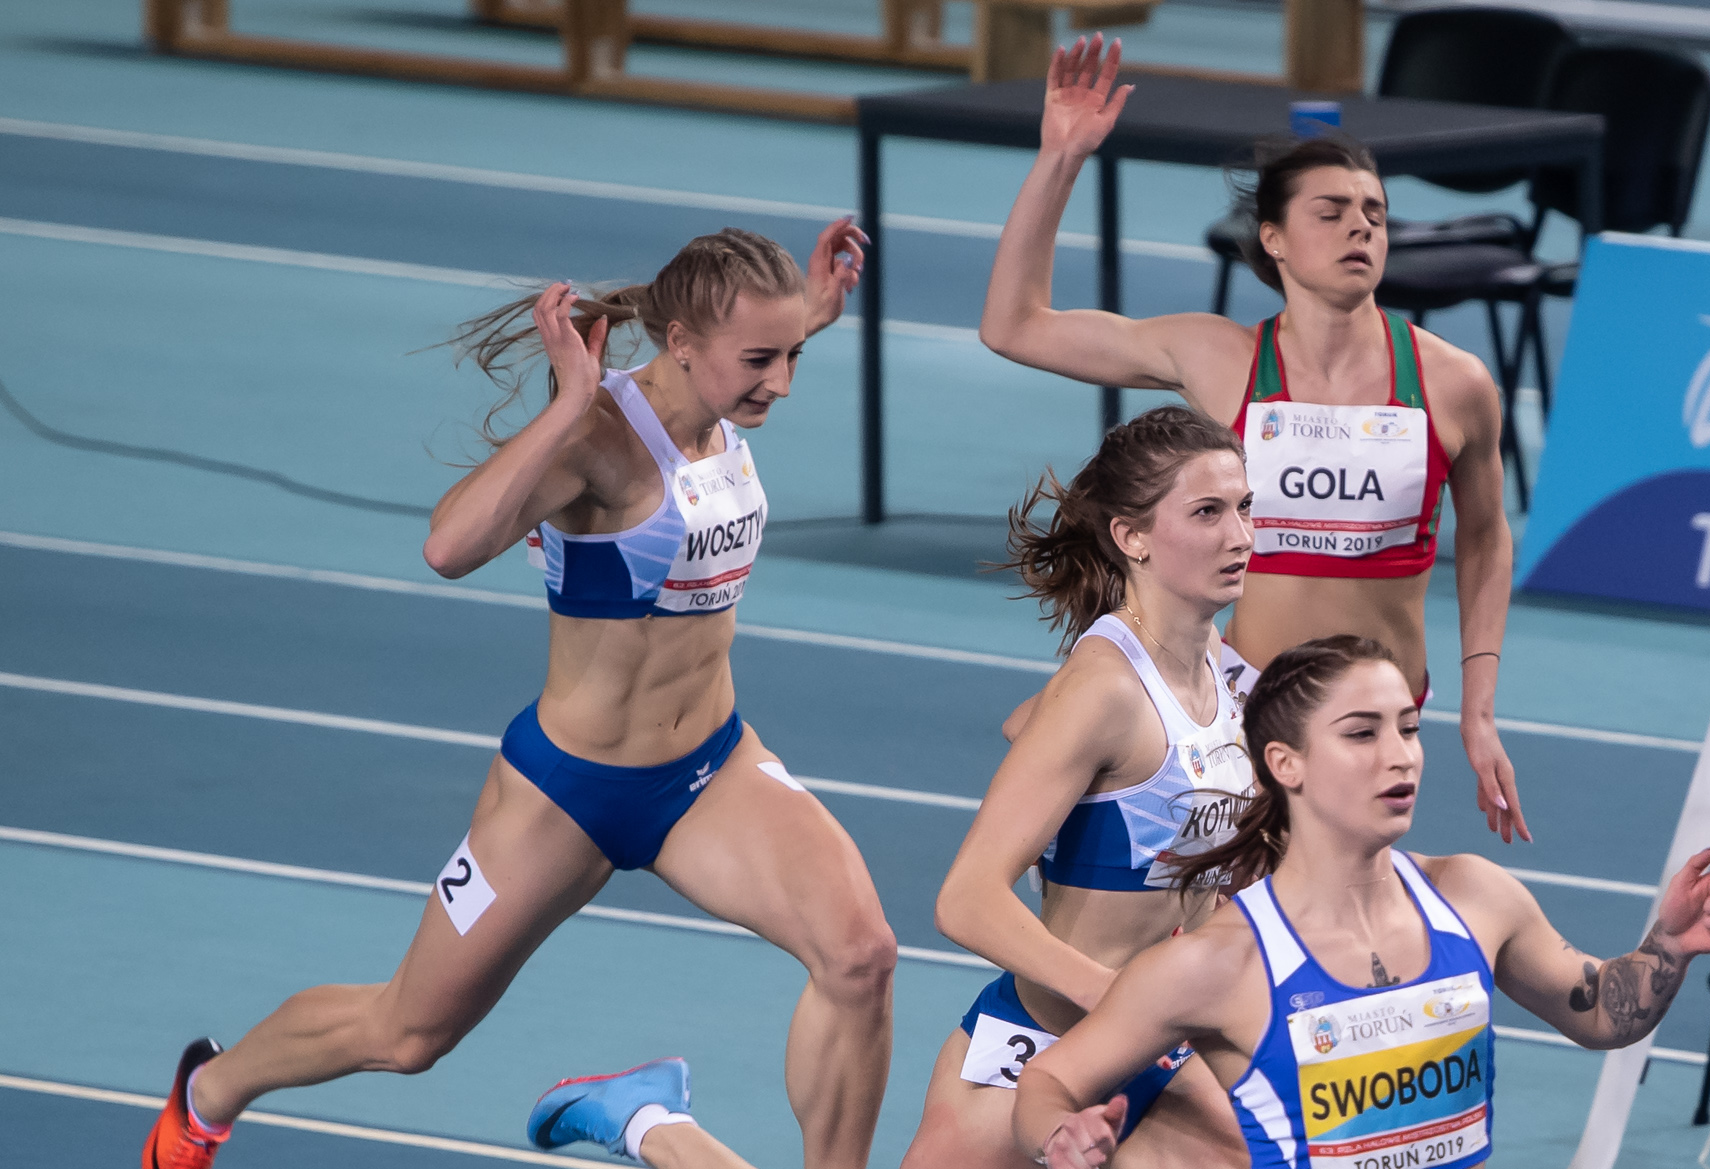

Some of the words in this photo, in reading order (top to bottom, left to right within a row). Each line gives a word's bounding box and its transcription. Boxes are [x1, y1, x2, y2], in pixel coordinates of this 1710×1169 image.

[1289, 421, 1351, 441] TORUŃ
[1293, 414, 1339, 426] MIASTO
[1278, 465, 1385, 501] GOLA
[1277, 532, 1338, 551] TORUŃ
[1343, 536, 1384, 551] 2019
[440, 857, 472, 904] 2
[1347, 1006, 1396, 1023] MIASTO
[1348, 1009, 1414, 1042] TORUŃ
[1000, 1034, 1037, 1083] 3
[1310, 1048, 1482, 1121] SWOBODA
[1426, 1136, 1464, 1163] 2019
